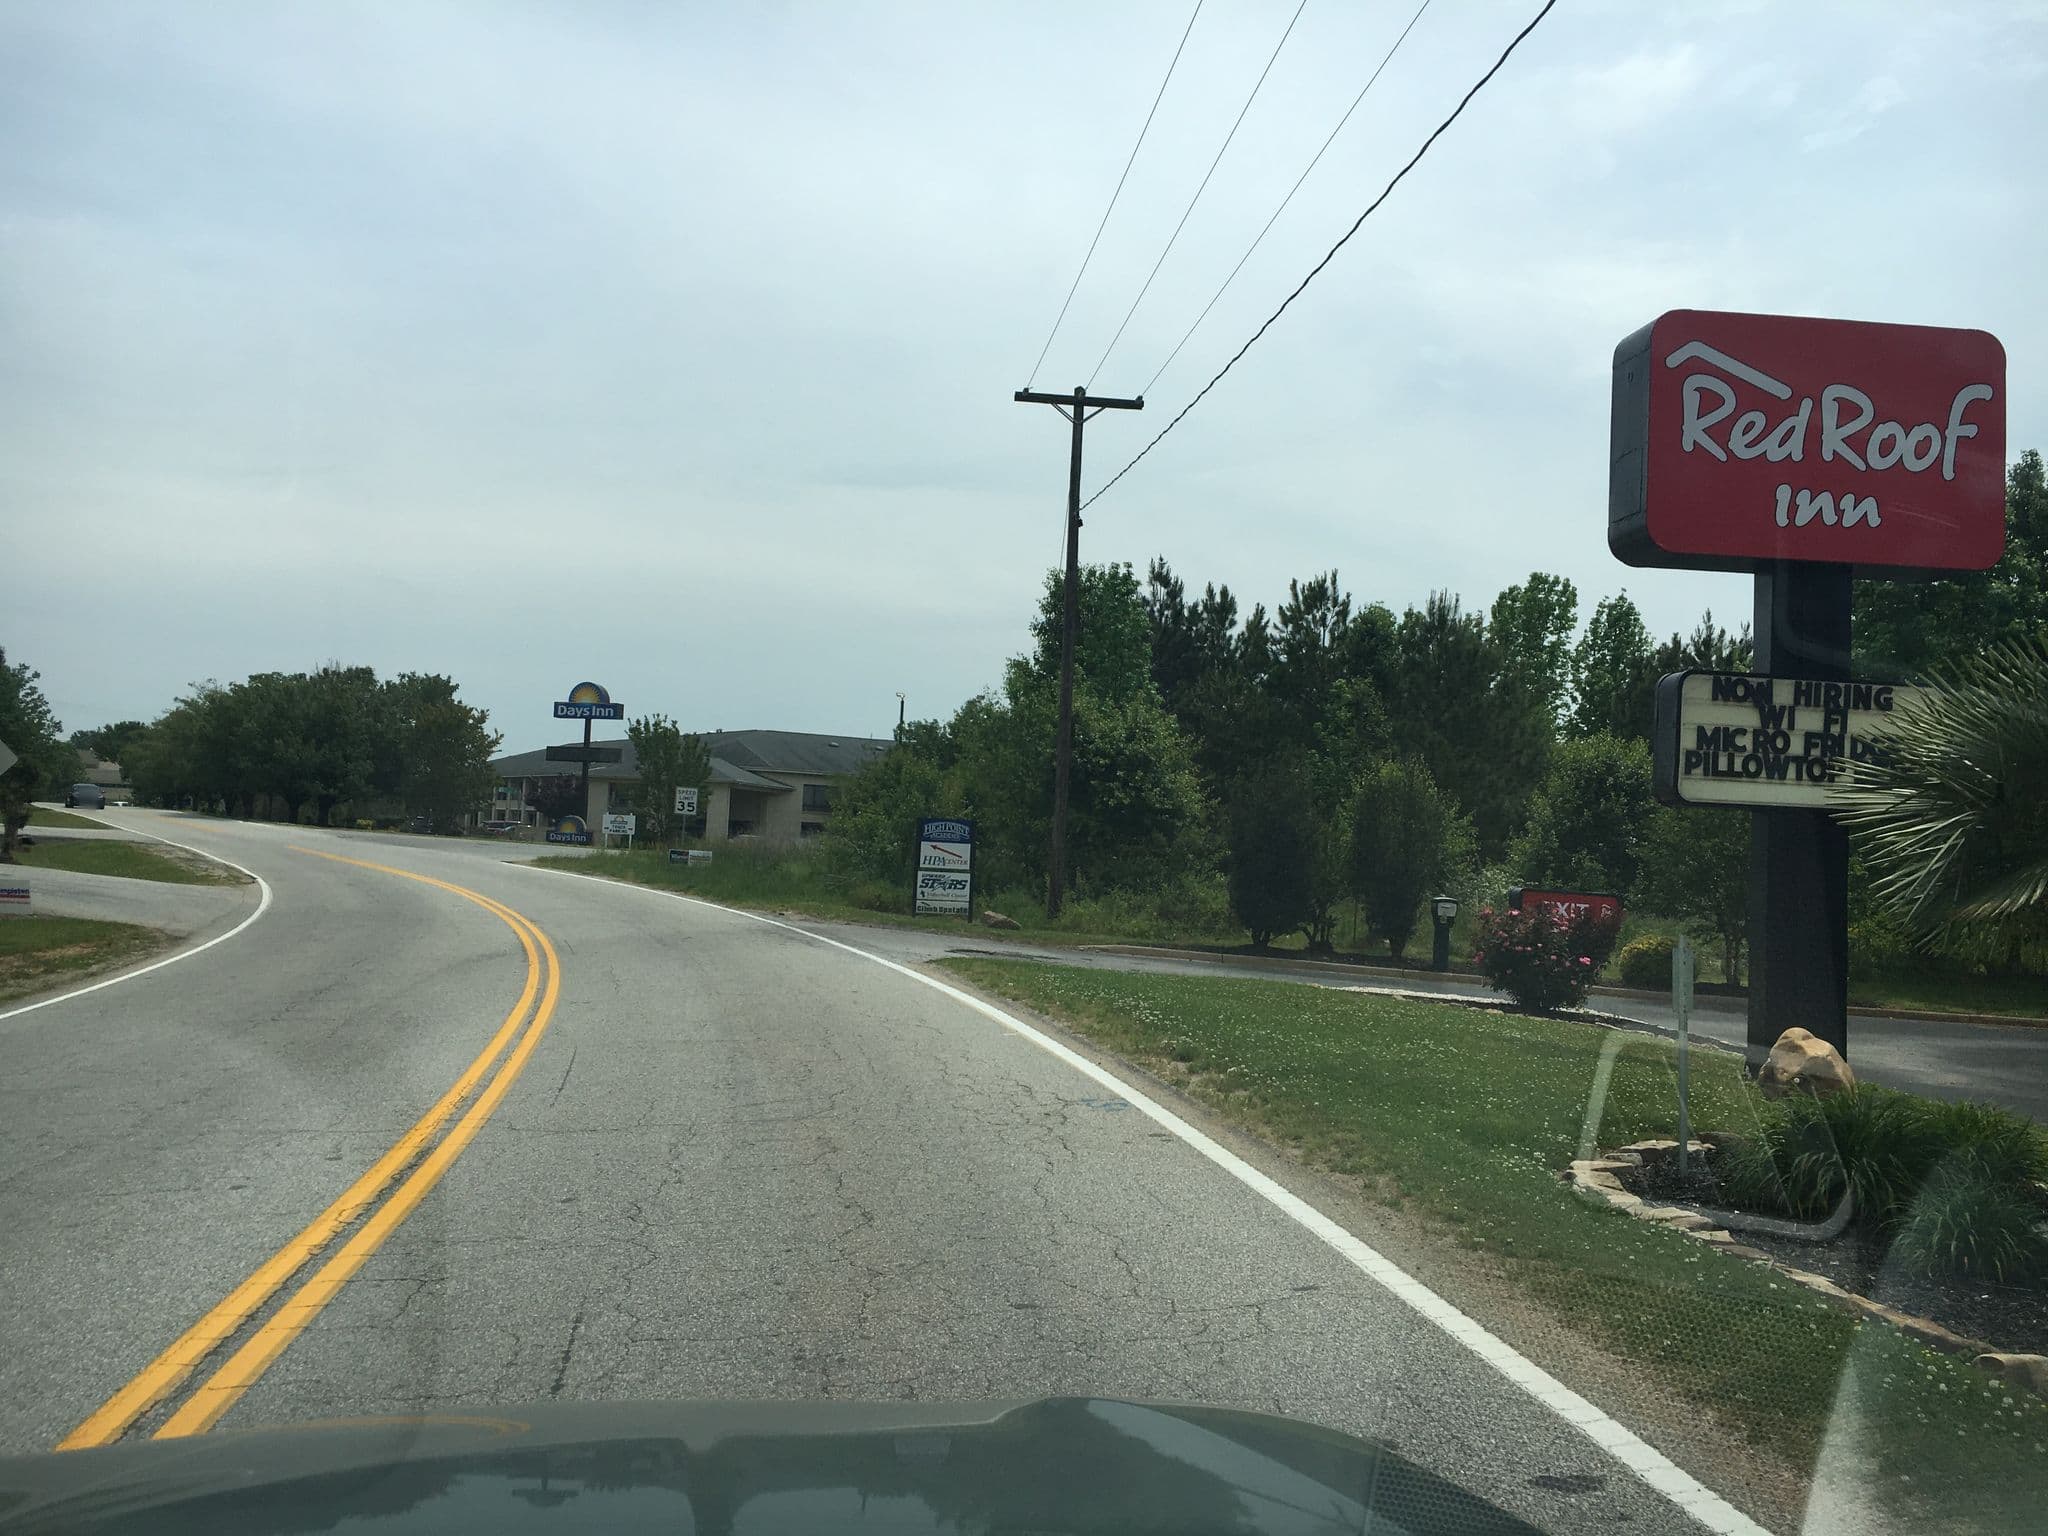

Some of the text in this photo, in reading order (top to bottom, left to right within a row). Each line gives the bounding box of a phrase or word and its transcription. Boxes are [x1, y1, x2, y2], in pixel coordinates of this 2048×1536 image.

[1681, 373, 1994, 481] Red Roof
[1774, 483, 1882, 528] Inn
[1711, 676, 1894, 710] NOW HIRING
[557, 705, 614, 717] Days Inn
[1758, 705, 1848, 733] WI FI
[677, 801, 695, 812] 35
[550, 832, 587, 842] Days Inn
[918, 878, 969, 891] STARS
